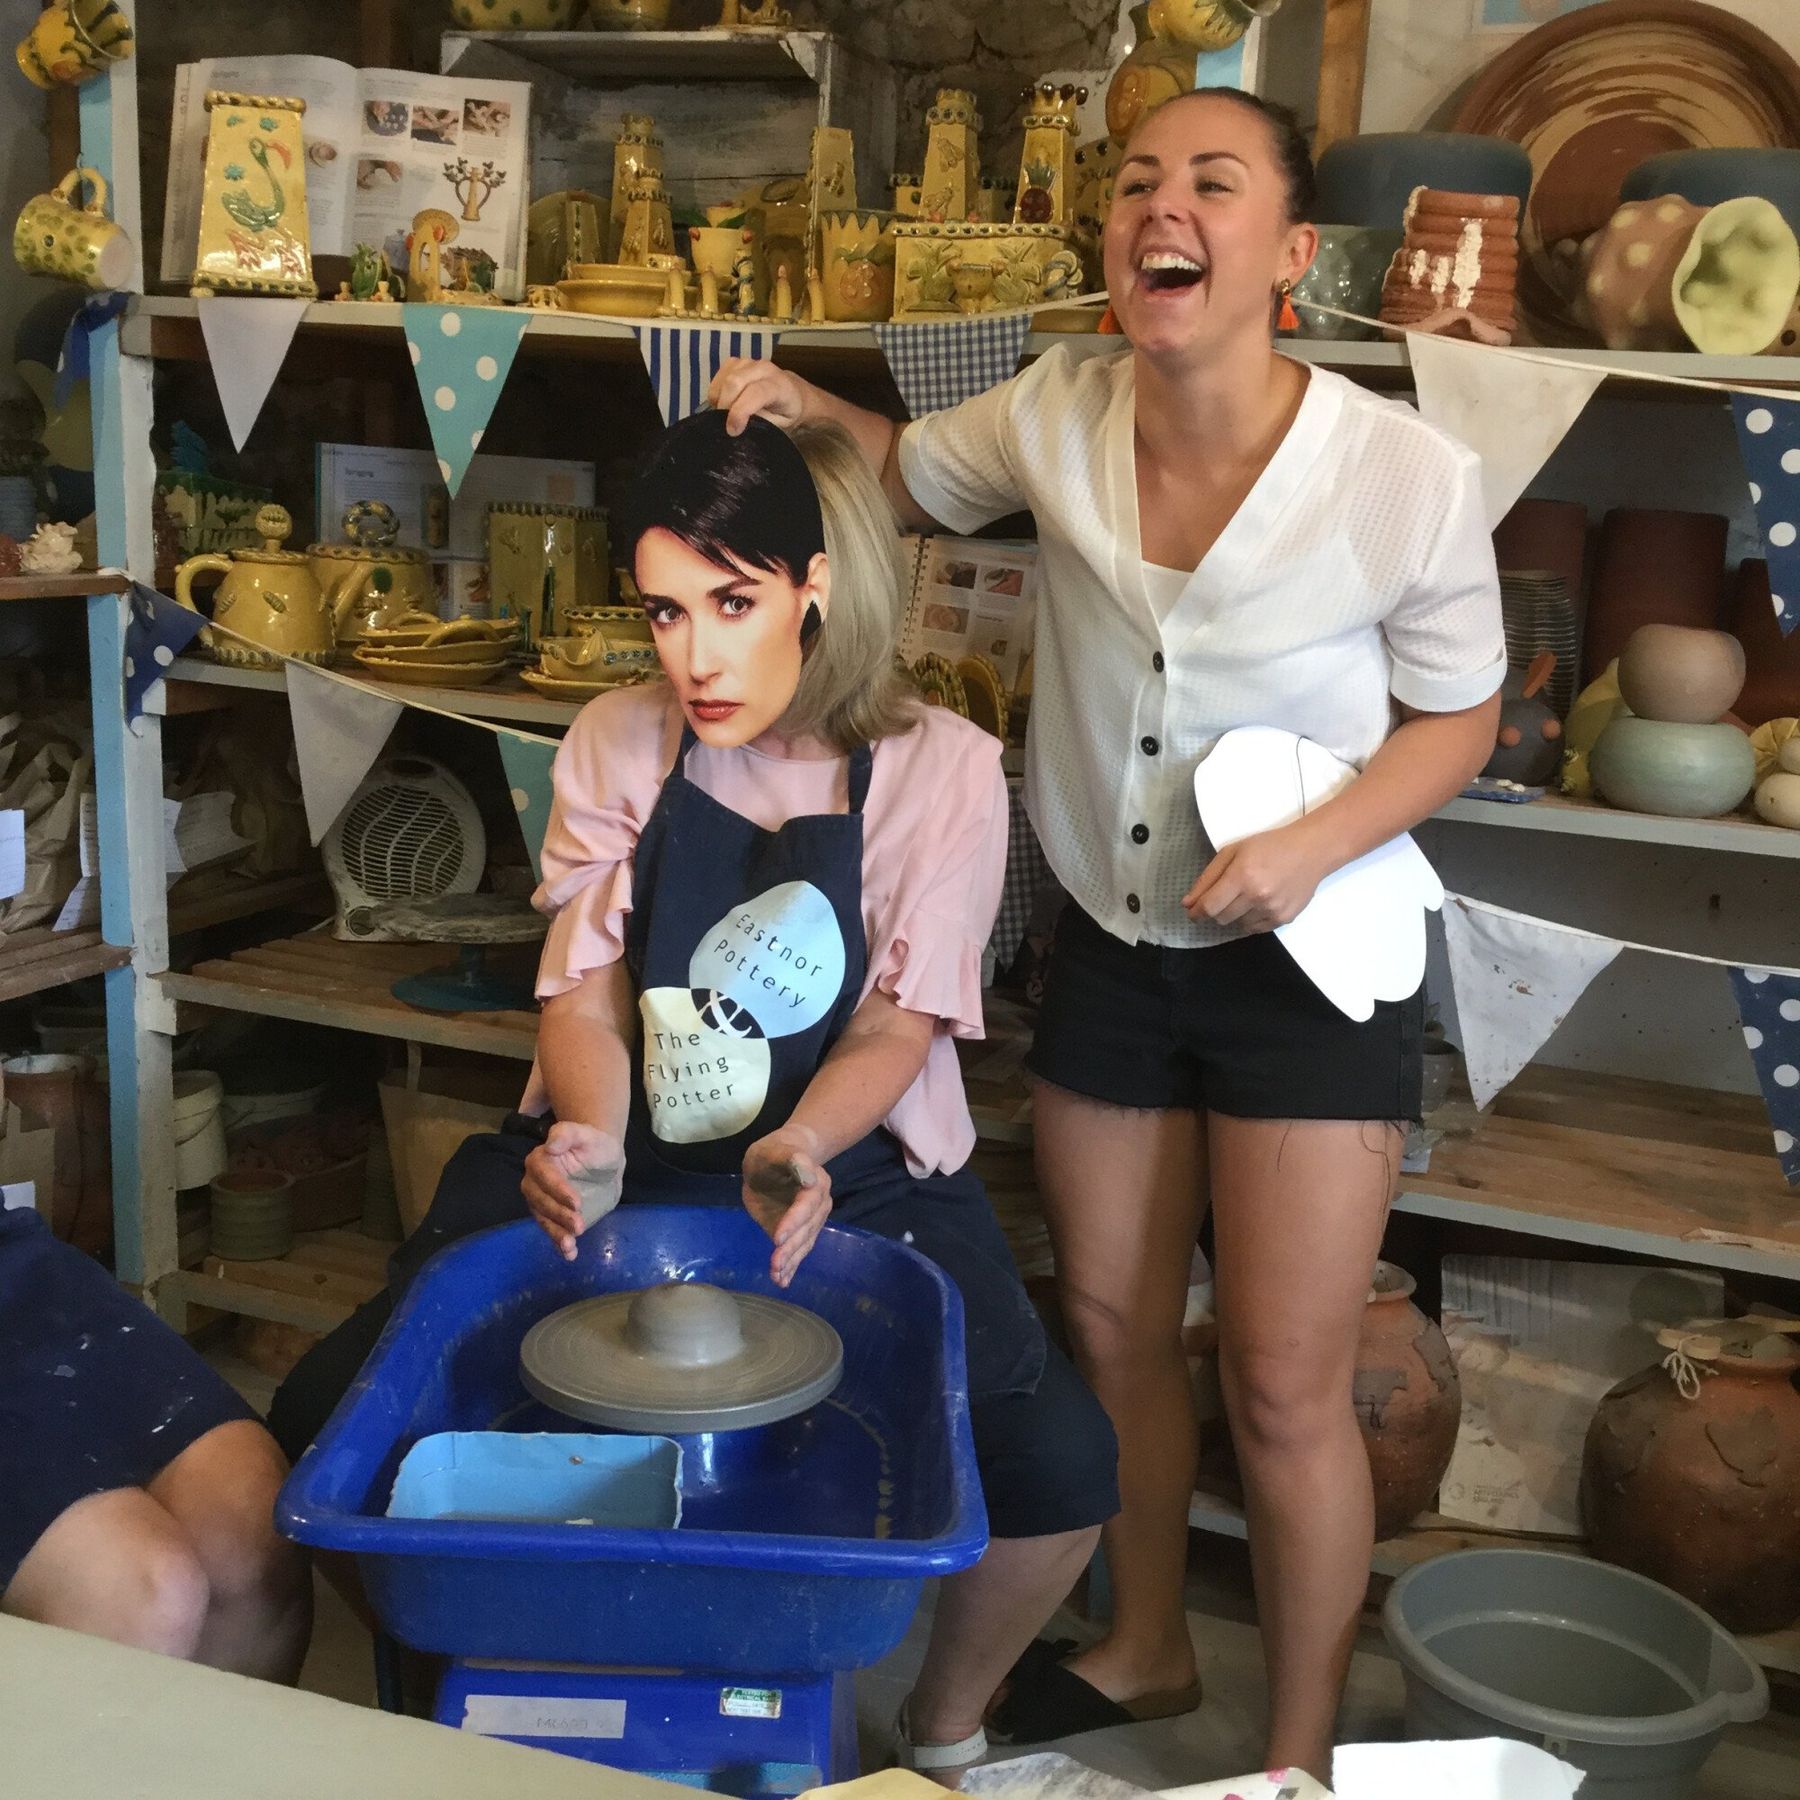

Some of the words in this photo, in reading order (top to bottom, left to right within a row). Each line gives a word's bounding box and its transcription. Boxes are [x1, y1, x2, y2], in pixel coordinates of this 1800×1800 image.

[735, 913, 823, 977] Eastnor
[713, 938, 806, 1008] Pottery
[654, 1032, 700, 1050] The
[647, 1056, 730, 1083] Flying
[652, 1083, 733, 1109] Potter
